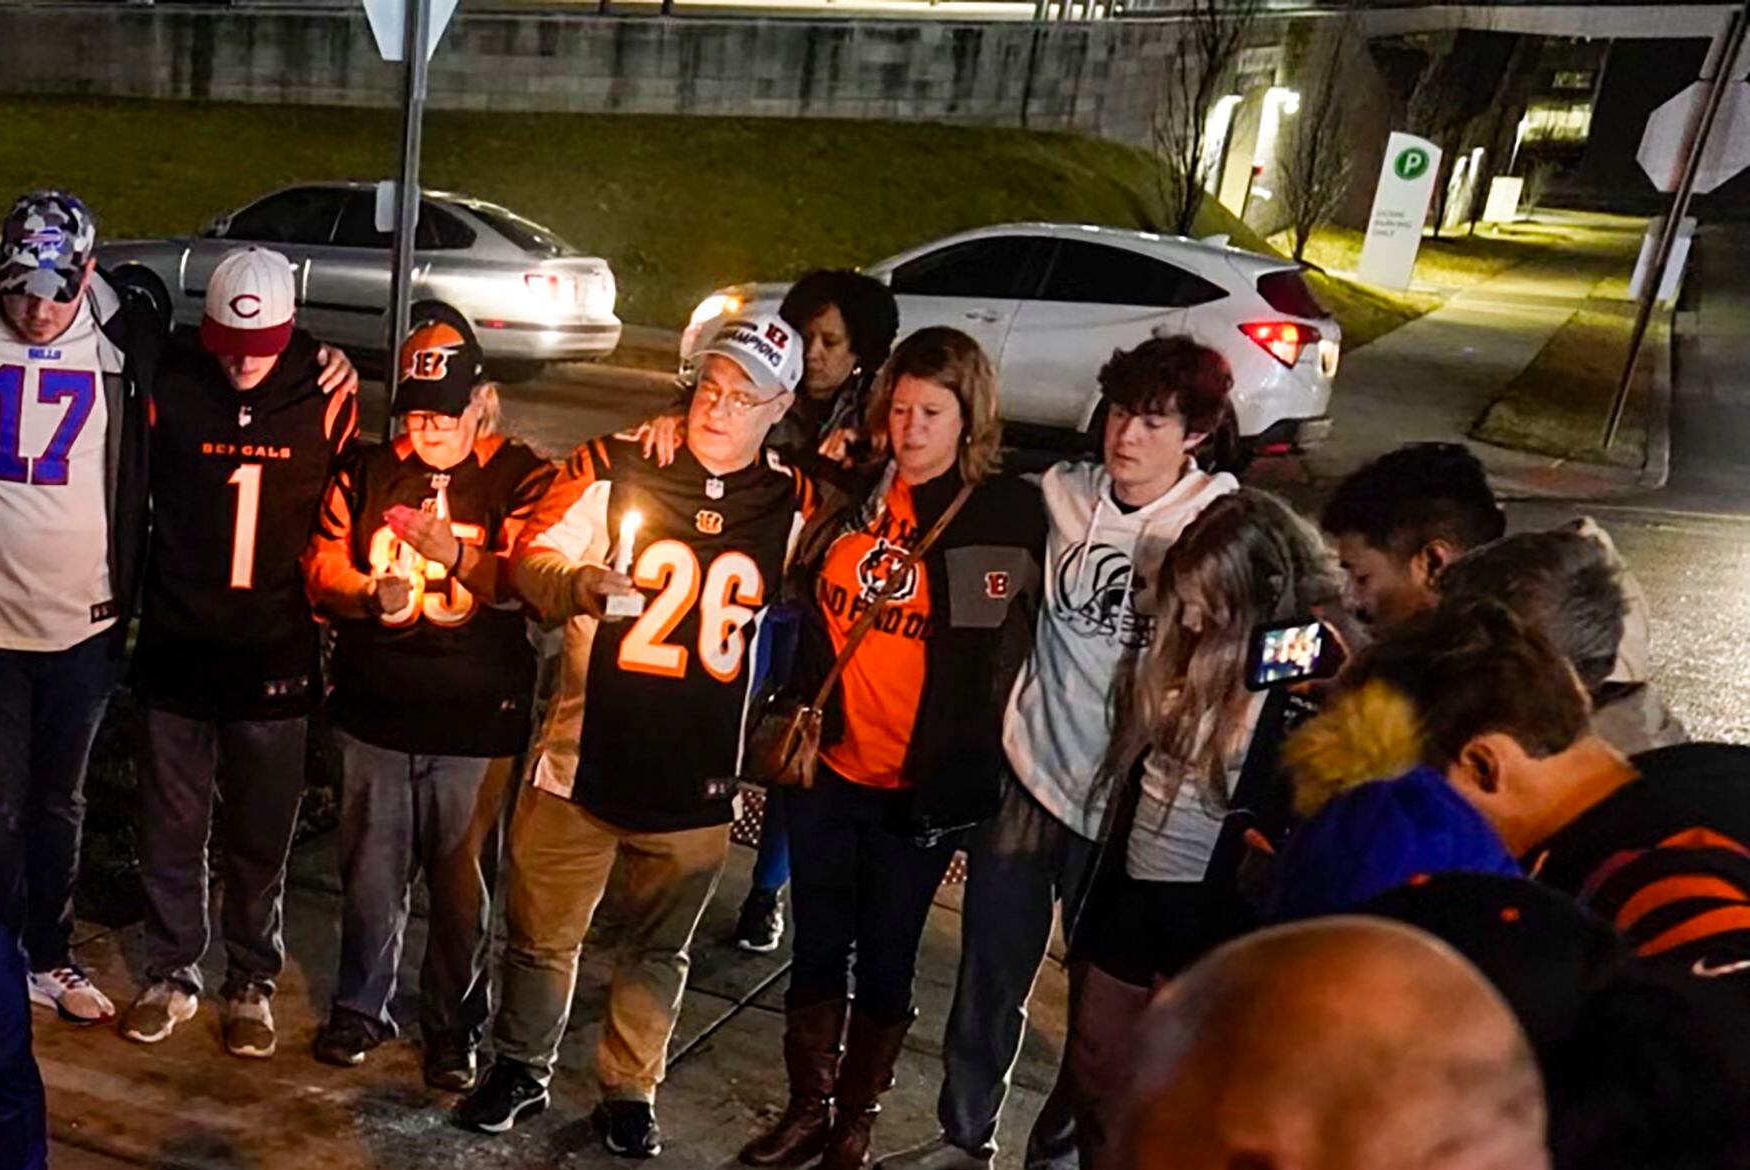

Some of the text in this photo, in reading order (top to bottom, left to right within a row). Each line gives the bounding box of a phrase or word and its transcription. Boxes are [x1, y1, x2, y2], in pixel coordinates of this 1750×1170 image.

[229, 294, 260, 318] C
[29, 348, 62, 360] BILLS
[226, 462, 265, 590] 1
[617, 538, 766, 684] 26
